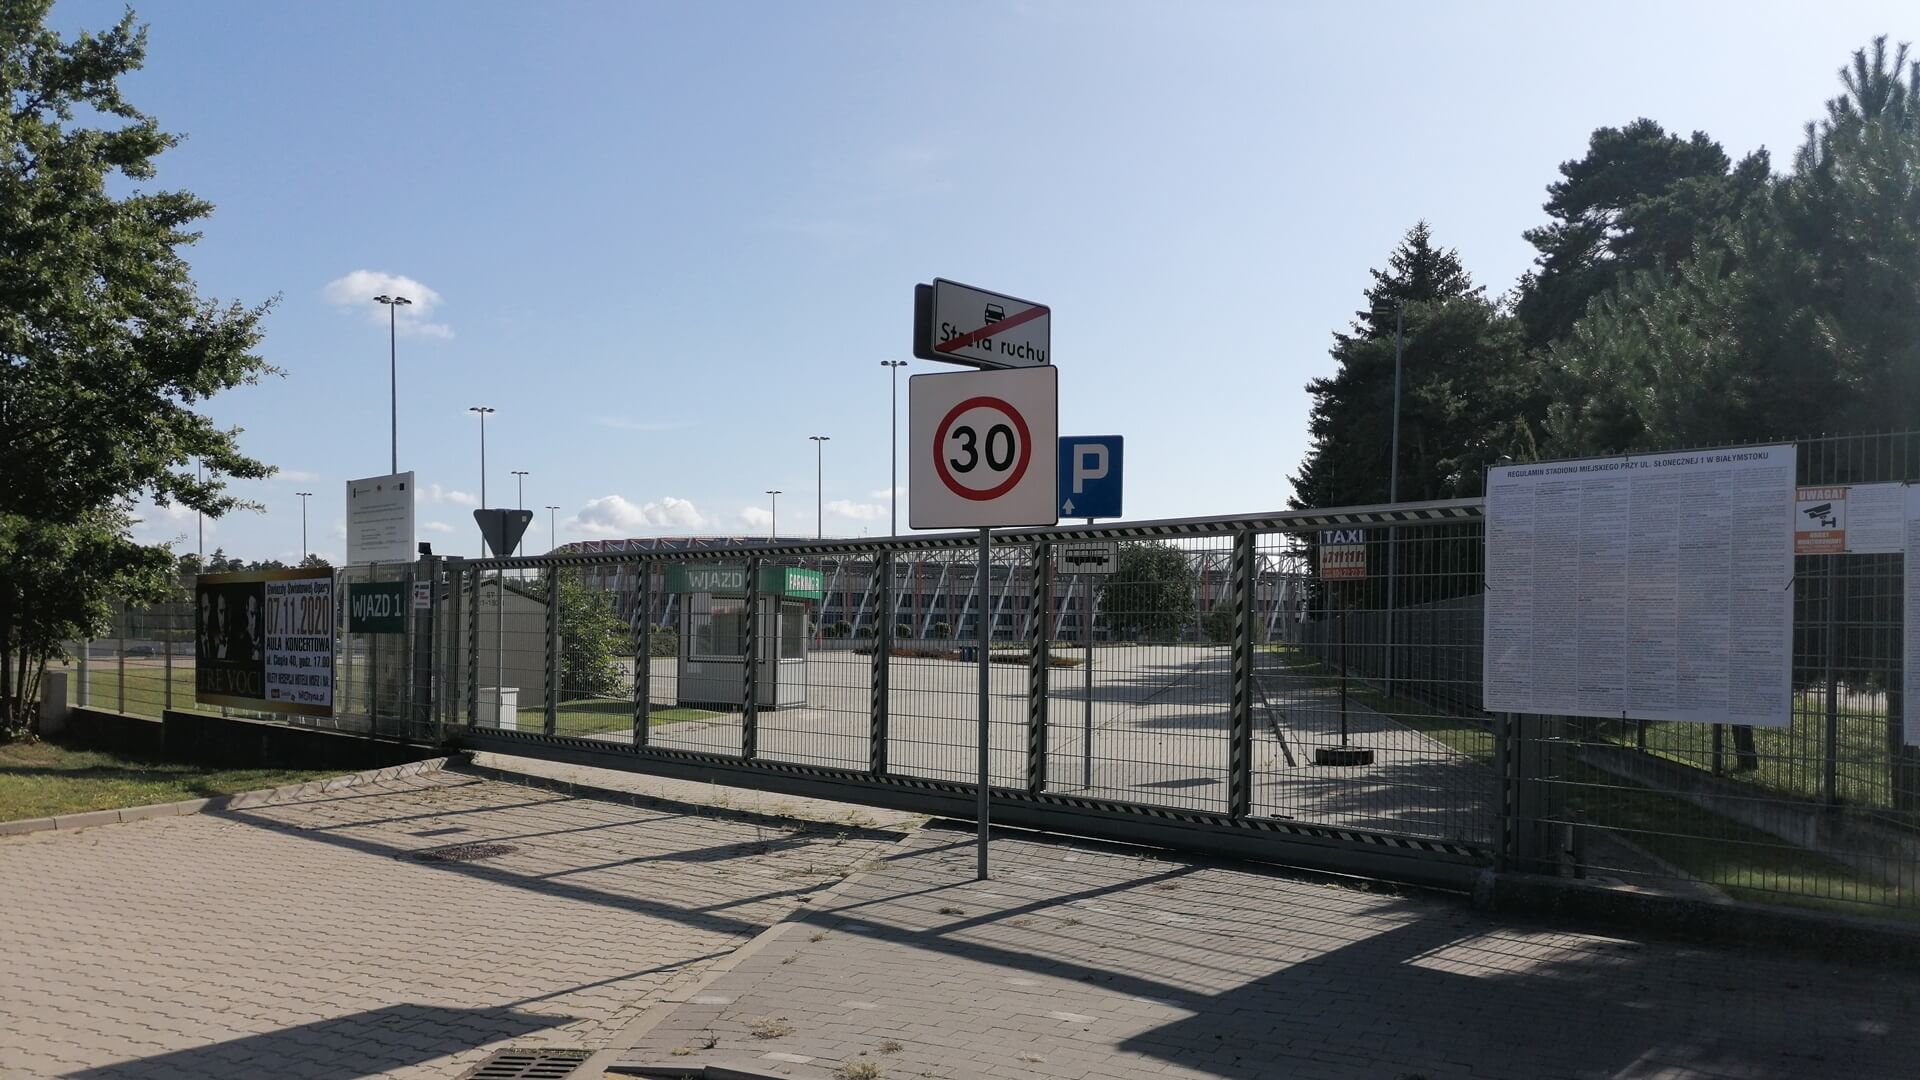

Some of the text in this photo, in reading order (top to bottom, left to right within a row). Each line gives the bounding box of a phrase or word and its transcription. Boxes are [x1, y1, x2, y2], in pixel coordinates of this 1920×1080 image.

[940, 322, 1045, 362] Sta ruchu
[950, 423, 1016, 474] 30
[1072, 443, 1109, 494] P
[1507, 470, 1544, 478] REGULAMIN
[1545, 467, 1578, 475] STADIONU
[1580, 463, 1619, 472] MIEJSKIEGO
[1620, 461, 1639, 470] PRZY
[1653, 457, 1699, 468] SŁONECZNEJ
[1706, 456, 1714, 464] W
[1715, 452, 1769, 463] BIAŁYMSTOKU
[1799, 489, 1843, 500] UWAGA!
[1326, 529, 1364, 545] TAXI
[688, 571, 742, 590] WJAZD
[266, 595, 330, 635] 07.11.2020
[352, 593, 402, 622] WJAZD 1
[266, 636, 330, 652] AULA KONCERTOWA
[313, 656, 330, 668] 17.00
[226, 669, 261, 695] VOCI
